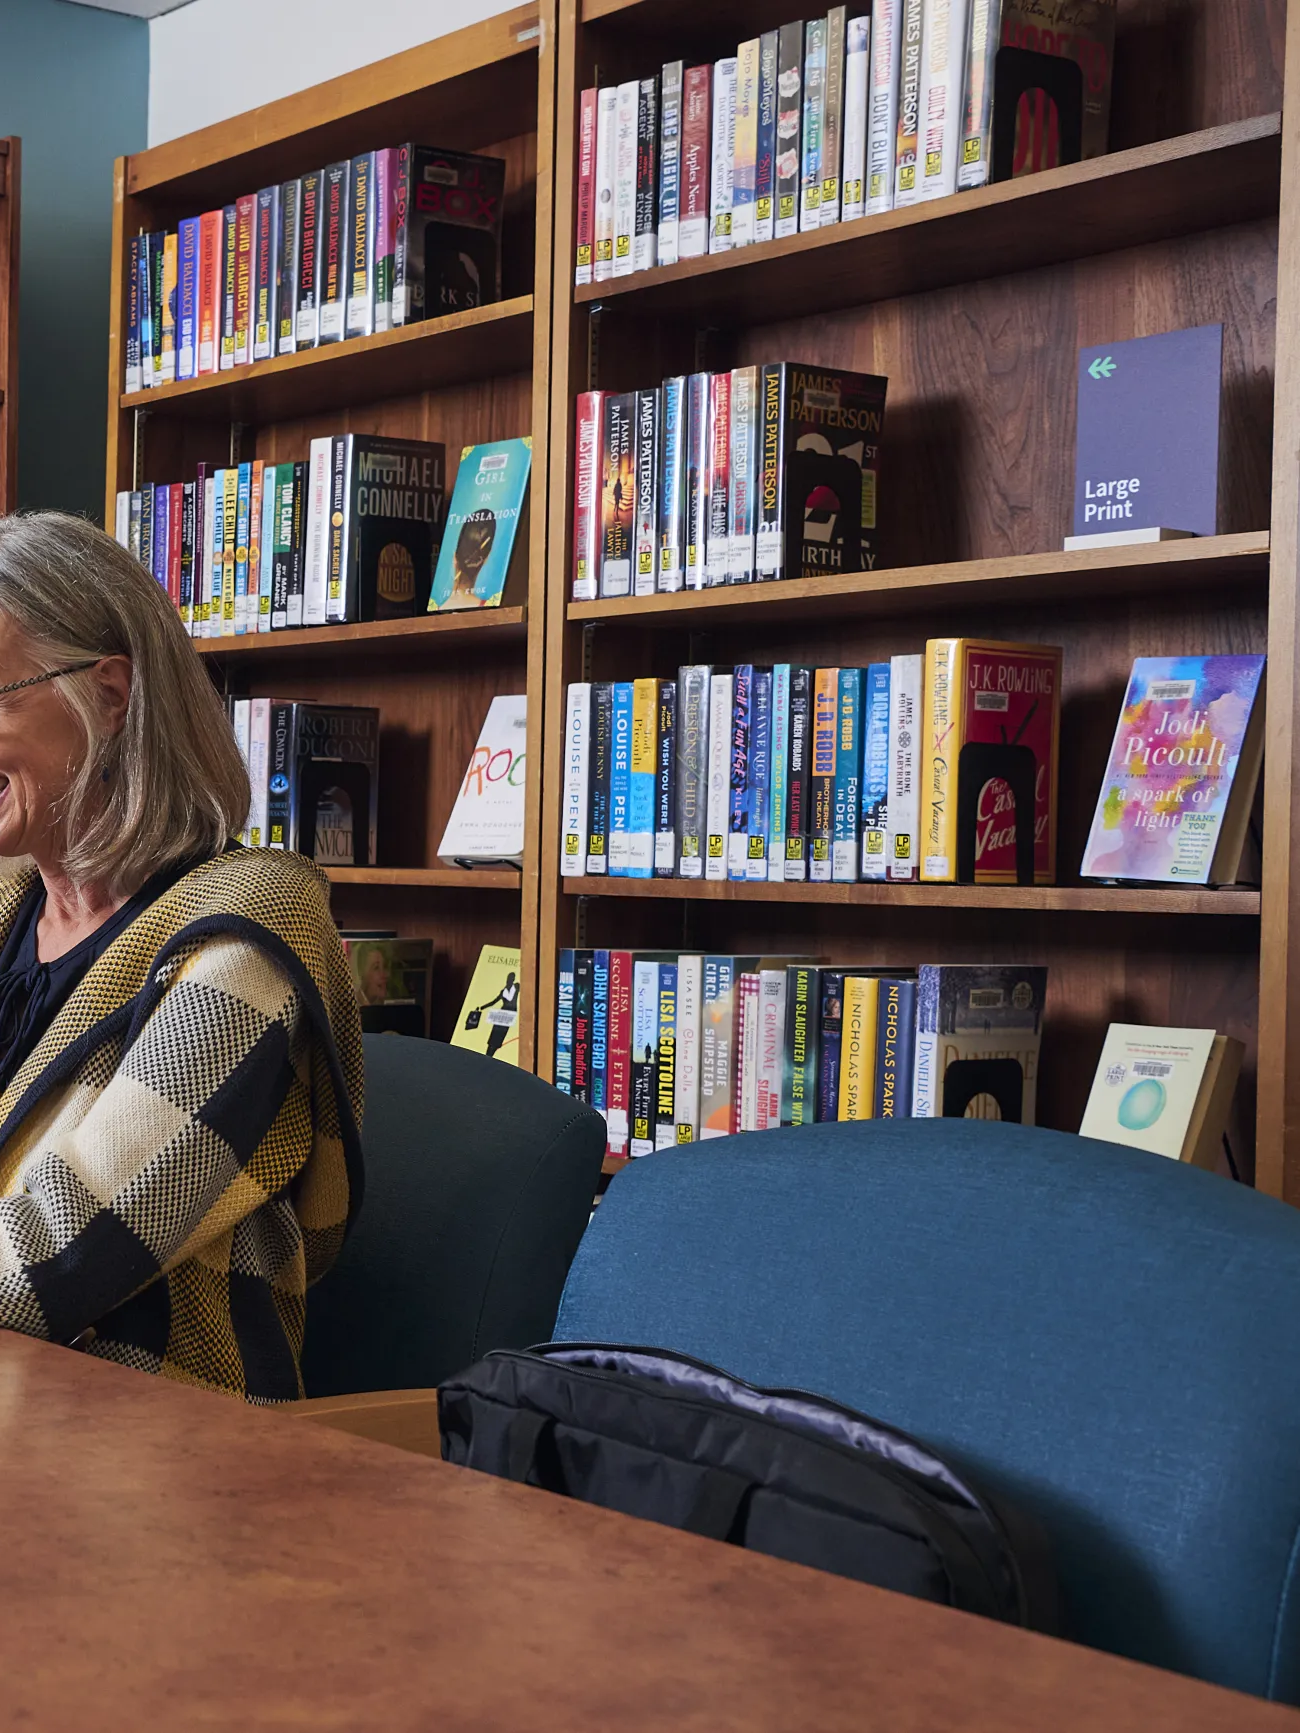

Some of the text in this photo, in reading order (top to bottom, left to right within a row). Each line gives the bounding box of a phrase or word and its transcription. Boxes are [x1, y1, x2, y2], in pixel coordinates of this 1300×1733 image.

[902, 45, 918, 137] PATTERSON
[966, 140, 979, 152] LP
[684, 144, 700, 216] Apples Never
[415, 184, 496, 223] BOX
[636, 193, 644, 232] FLYNN
[644, 191, 652, 230] VINCE
[302, 192, 315, 288] DAVID BALDACCI
[182, 224, 194, 315] DAVID BALDACCI
[641, 397, 653, 514] JAMES PATTERSON
[764, 374, 779, 509] JAMES PATTERSON
[474, 470, 507, 485] GIRL
[1085, 478, 1140, 500] Large
[225, 493, 234, 544] LEE CHILD
[280, 482, 293, 545] TOM CLANCY
[358, 487, 442, 523] CONNELLY
[448, 506, 517, 527] TRANSLATION
[1084, 500, 1132, 522] Print
[278, 710, 286, 727] THE
[816, 693, 833, 772] J. D. ROBB
[898, 693, 906, 729] ROLLINS
[1154, 710, 1208, 735] Jodi
[616, 710, 628, 770] LOUISE
[792, 715, 803, 771] KAREN ROBARDS
[870, 693, 887, 793] NORA ROBERTS
[1121, 737, 1227, 767] Picoult
[1117, 786, 1213, 806] a spark of
[1184, 813, 1216, 822] THANK
[897, 837, 908, 847] LP
[1134, 811, 1178, 832] light
[1188, 822, 1206, 830] YOU
[788, 839, 801, 849] LP
[558, 985, 573, 1045] SANDFORD
[792, 971, 807, 1098] KARIN SLAUGHTER FALSE
[884, 986, 898, 1067] NICHOLAS
[575, 1018, 587, 1086] John Sandford
[658, 991, 675, 1114] LISA SCOTTOLINE
[703, 1028, 714, 1096] SHIPSTEAD
[716, 1040, 728, 1087] MAGGIE
